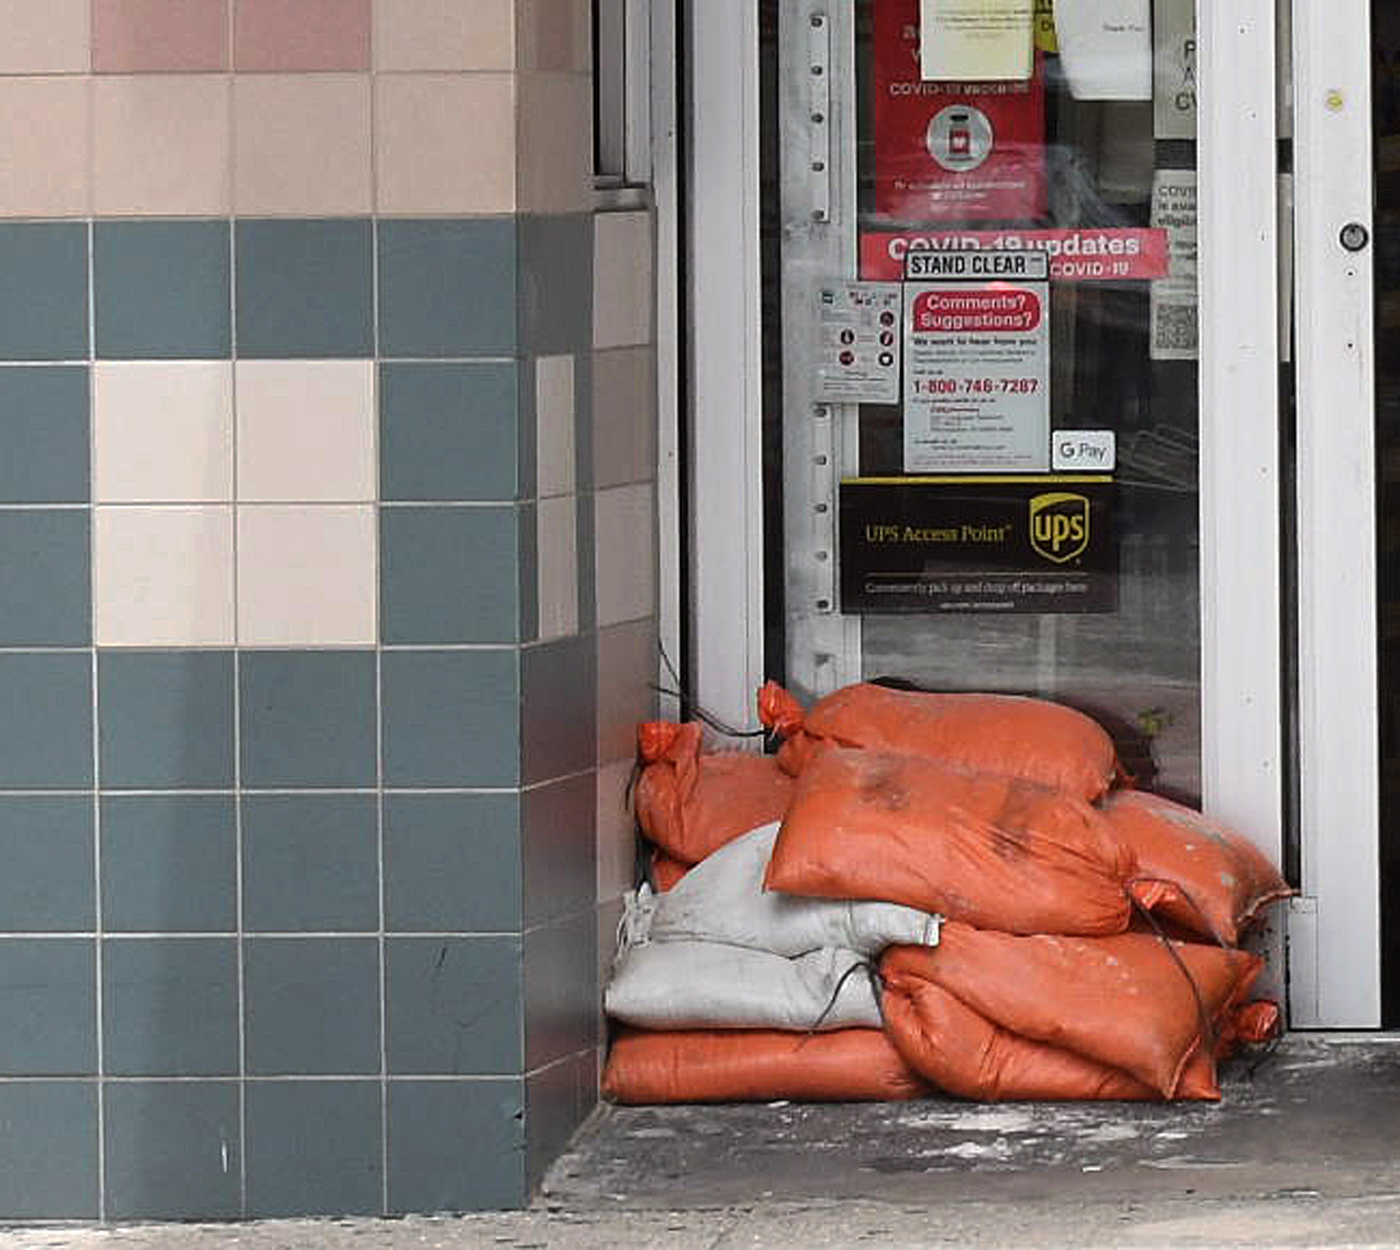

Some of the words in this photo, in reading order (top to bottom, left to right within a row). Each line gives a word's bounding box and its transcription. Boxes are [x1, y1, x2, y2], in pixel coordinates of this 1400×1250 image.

[910, 255, 965, 275] STAND
[972, 255, 1026, 274] CLEAR
[926, 294, 1026, 310] Comments?
[921, 312, 1033, 329] Suggestions?
[1060, 441, 1075, 459] G
[1078, 442, 1109, 462] Pay
[865, 524, 898, 542] UPS
[902, 524, 959, 542] Access
[961, 523, 1005, 542] Point
[1034, 513, 1084, 553] ups
